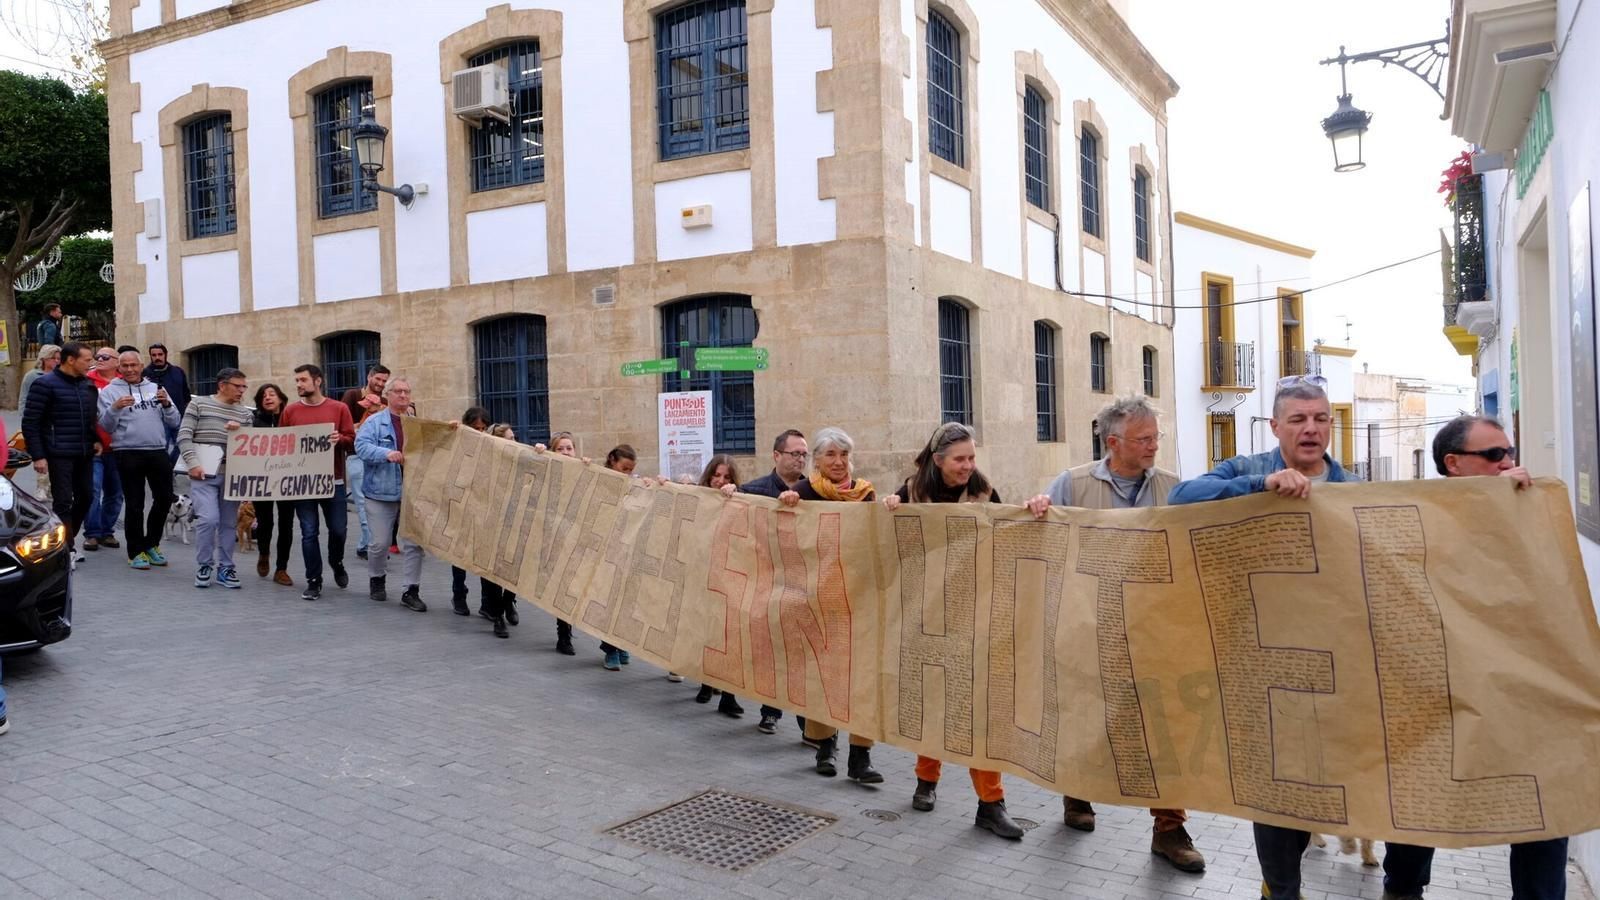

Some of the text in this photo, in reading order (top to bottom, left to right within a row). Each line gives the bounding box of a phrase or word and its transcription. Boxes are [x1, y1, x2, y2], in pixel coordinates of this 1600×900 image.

[664, 409, 706, 418] LANZAMIENTO
[672, 417, 706, 427] CARAMELOS
[229, 474, 273, 498] HOTEL
[280, 473, 335, 497] GENOVESES
[702, 498, 852, 722] SIN
[893, 505, 1546, 833] HOTEL
